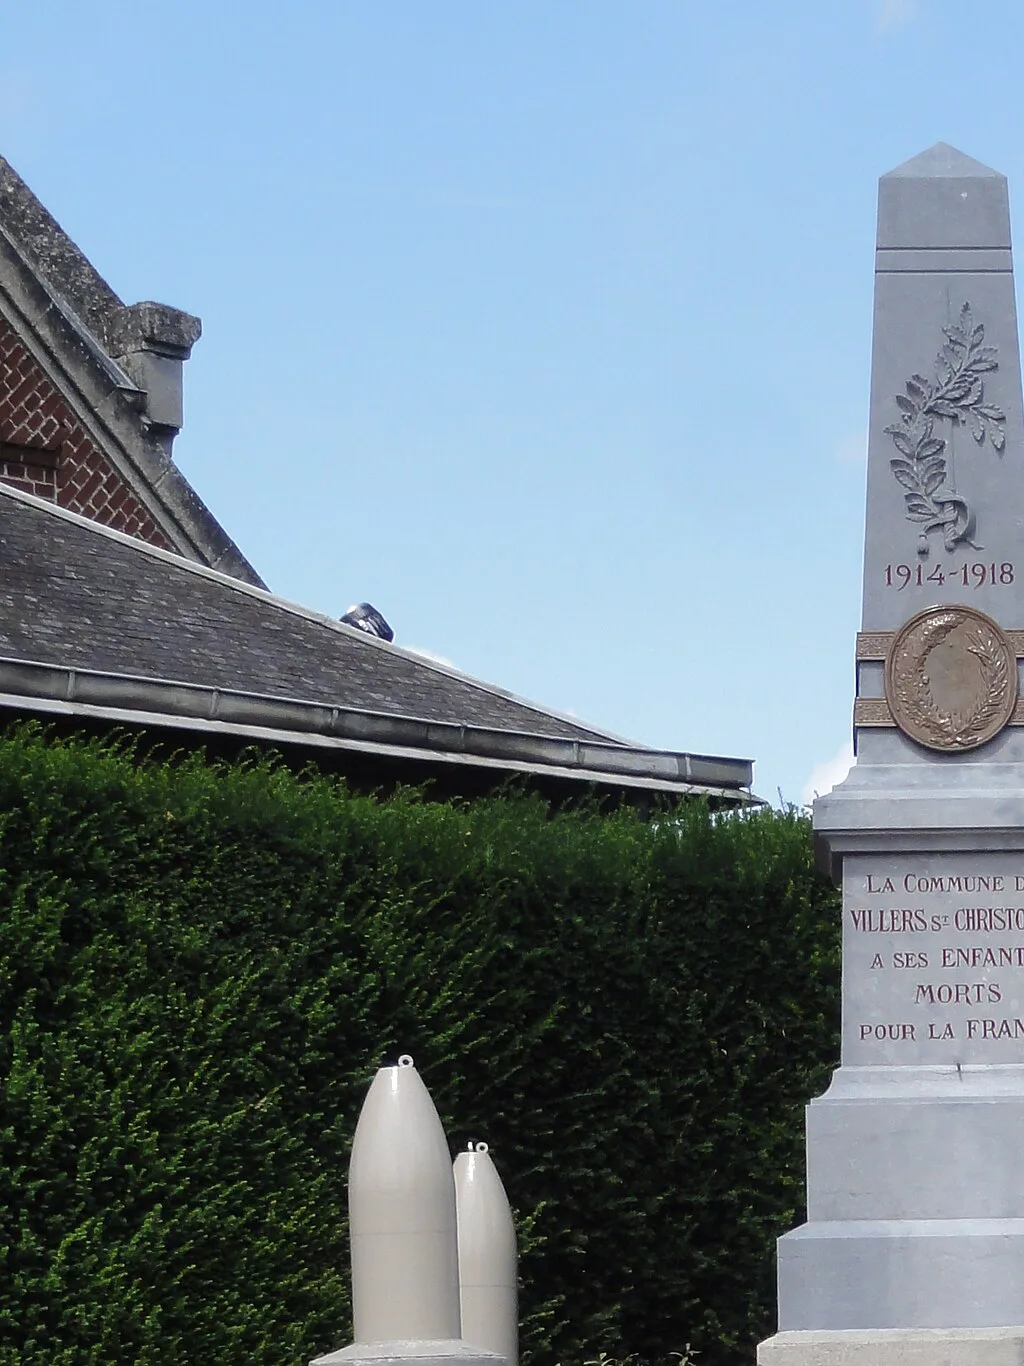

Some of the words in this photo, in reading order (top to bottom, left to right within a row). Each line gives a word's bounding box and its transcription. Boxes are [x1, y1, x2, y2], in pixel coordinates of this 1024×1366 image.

[884, 562, 1015, 592] 1914-1918
[866, 874, 894, 893] LA
[904, 873, 1004, 892] COMMUNE
[850, 909, 927, 932] VILLERS
[870, 953, 883, 969] A
[893, 953, 928, 968] SES
[914, 983, 1002, 1006] MORTS
[860, 1024, 915, 1041] POUR
[928, 1023, 954, 1040] LA
